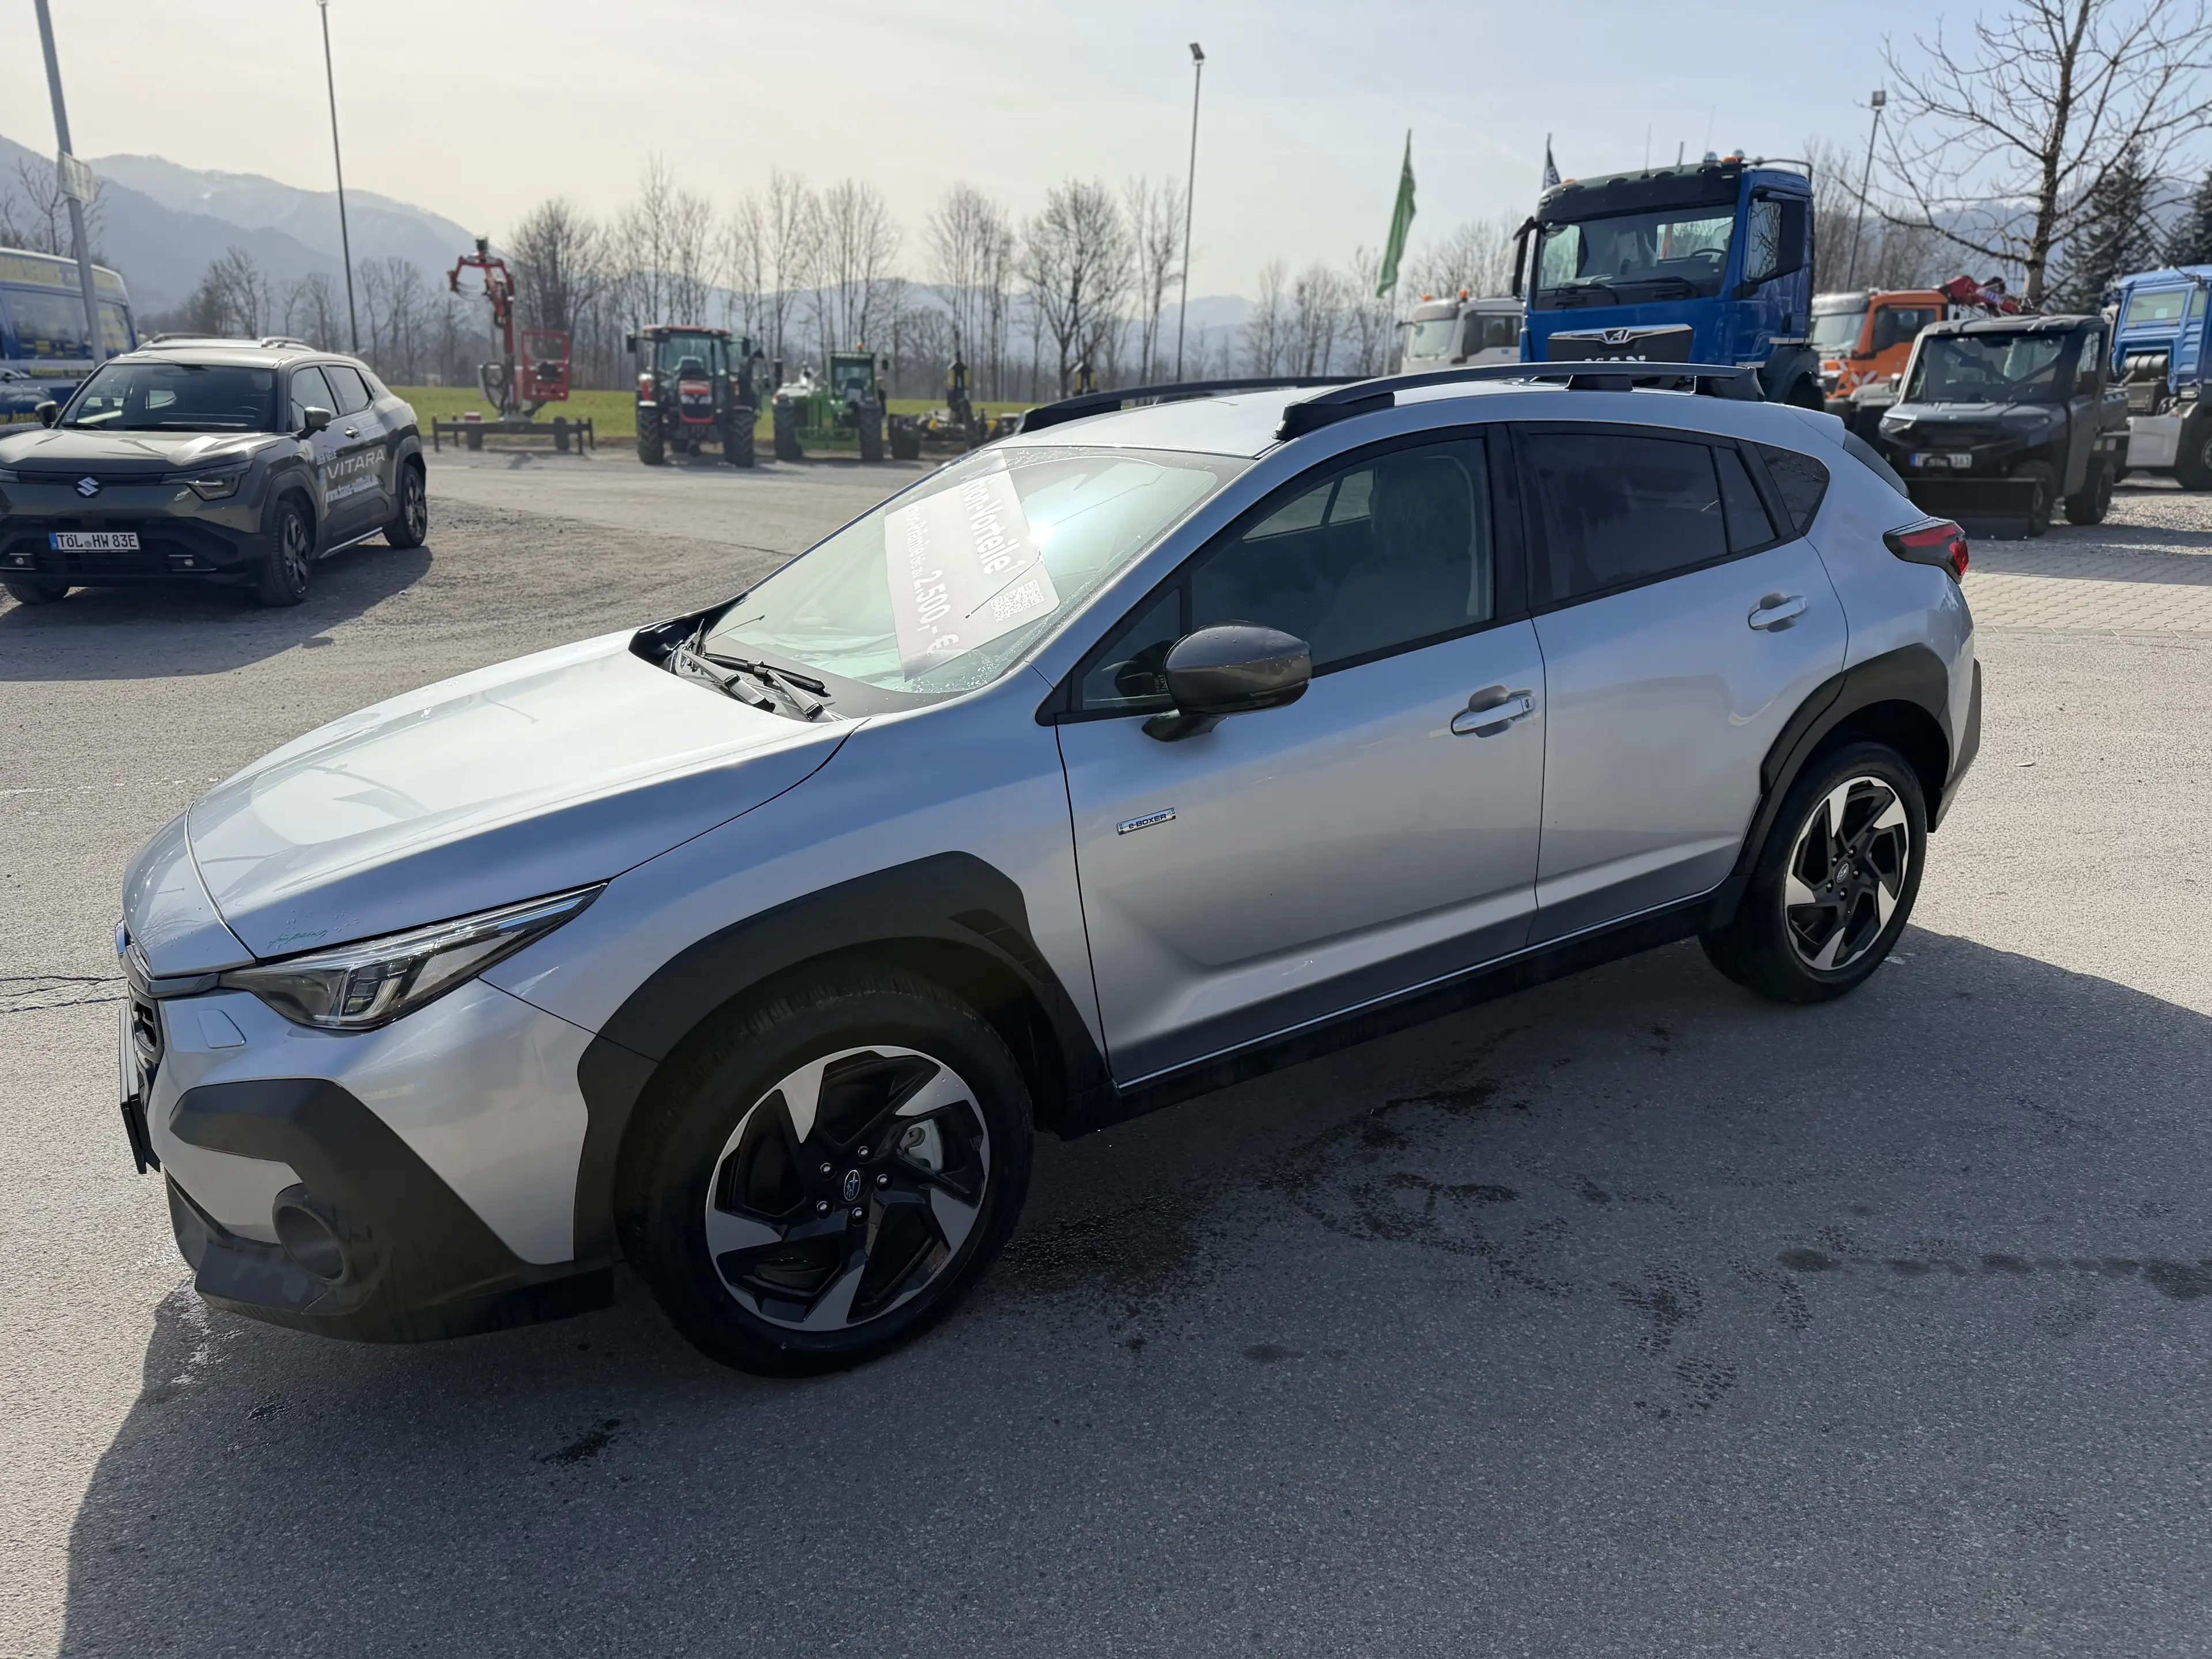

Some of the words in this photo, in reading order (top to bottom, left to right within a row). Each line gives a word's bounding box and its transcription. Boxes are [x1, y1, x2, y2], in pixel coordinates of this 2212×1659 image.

[327, 449, 385, 479] VITARA
[58, 534, 84, 548] TÖL
[92, 534, 109, 548] HW
[112, 534, 137, 548] 83E
[1128, 813, 1167, 829] e-BOXER
